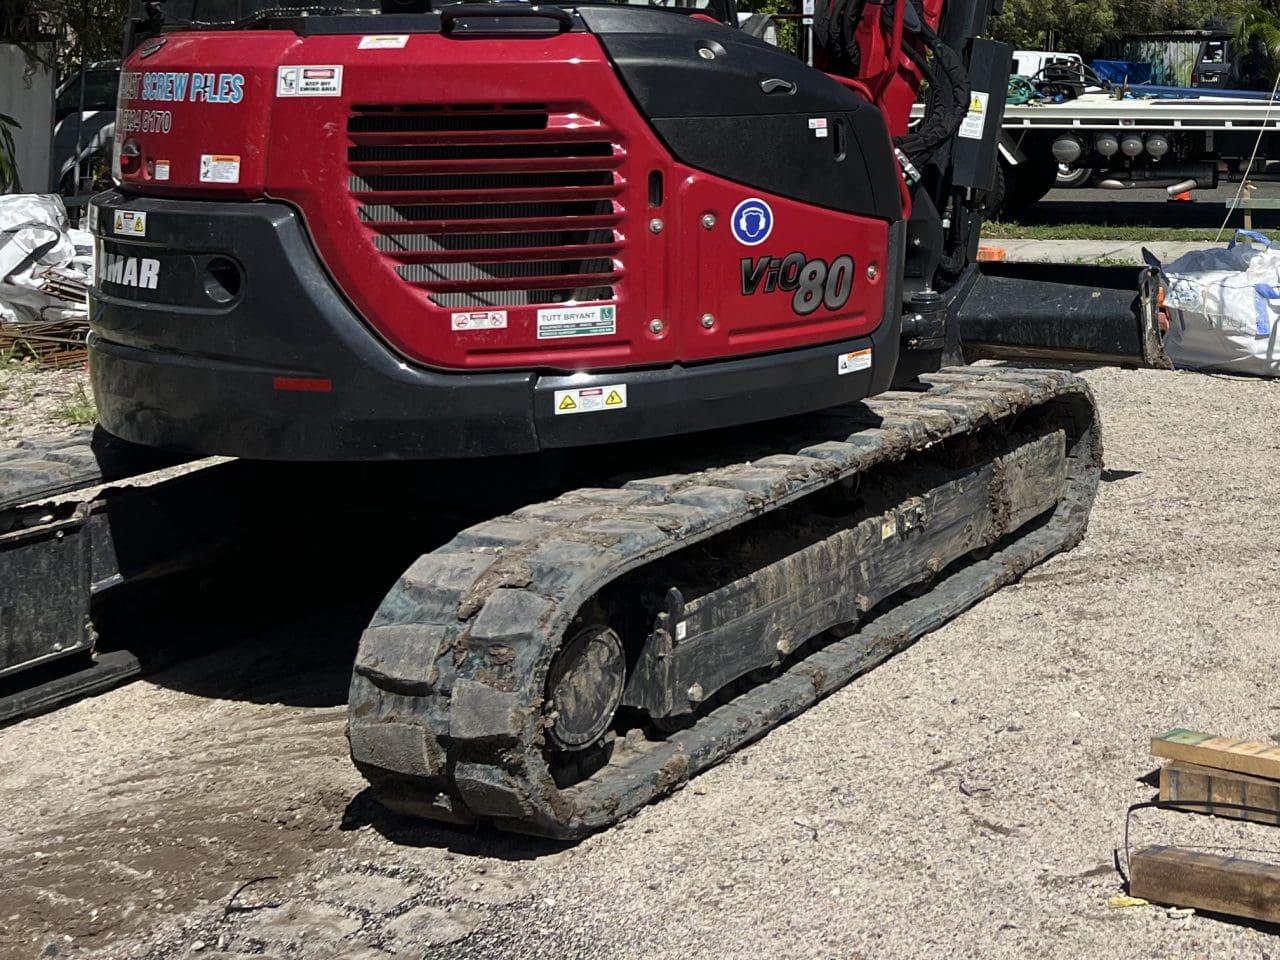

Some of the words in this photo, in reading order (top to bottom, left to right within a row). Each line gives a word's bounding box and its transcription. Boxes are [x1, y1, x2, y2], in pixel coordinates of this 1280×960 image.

[142, 72, 189, 102] SCREW
[142, 110, 172, 134] 8170
[541, 314, 562, 322] TUTT
[563, 312, 596, 321] BRYANT
